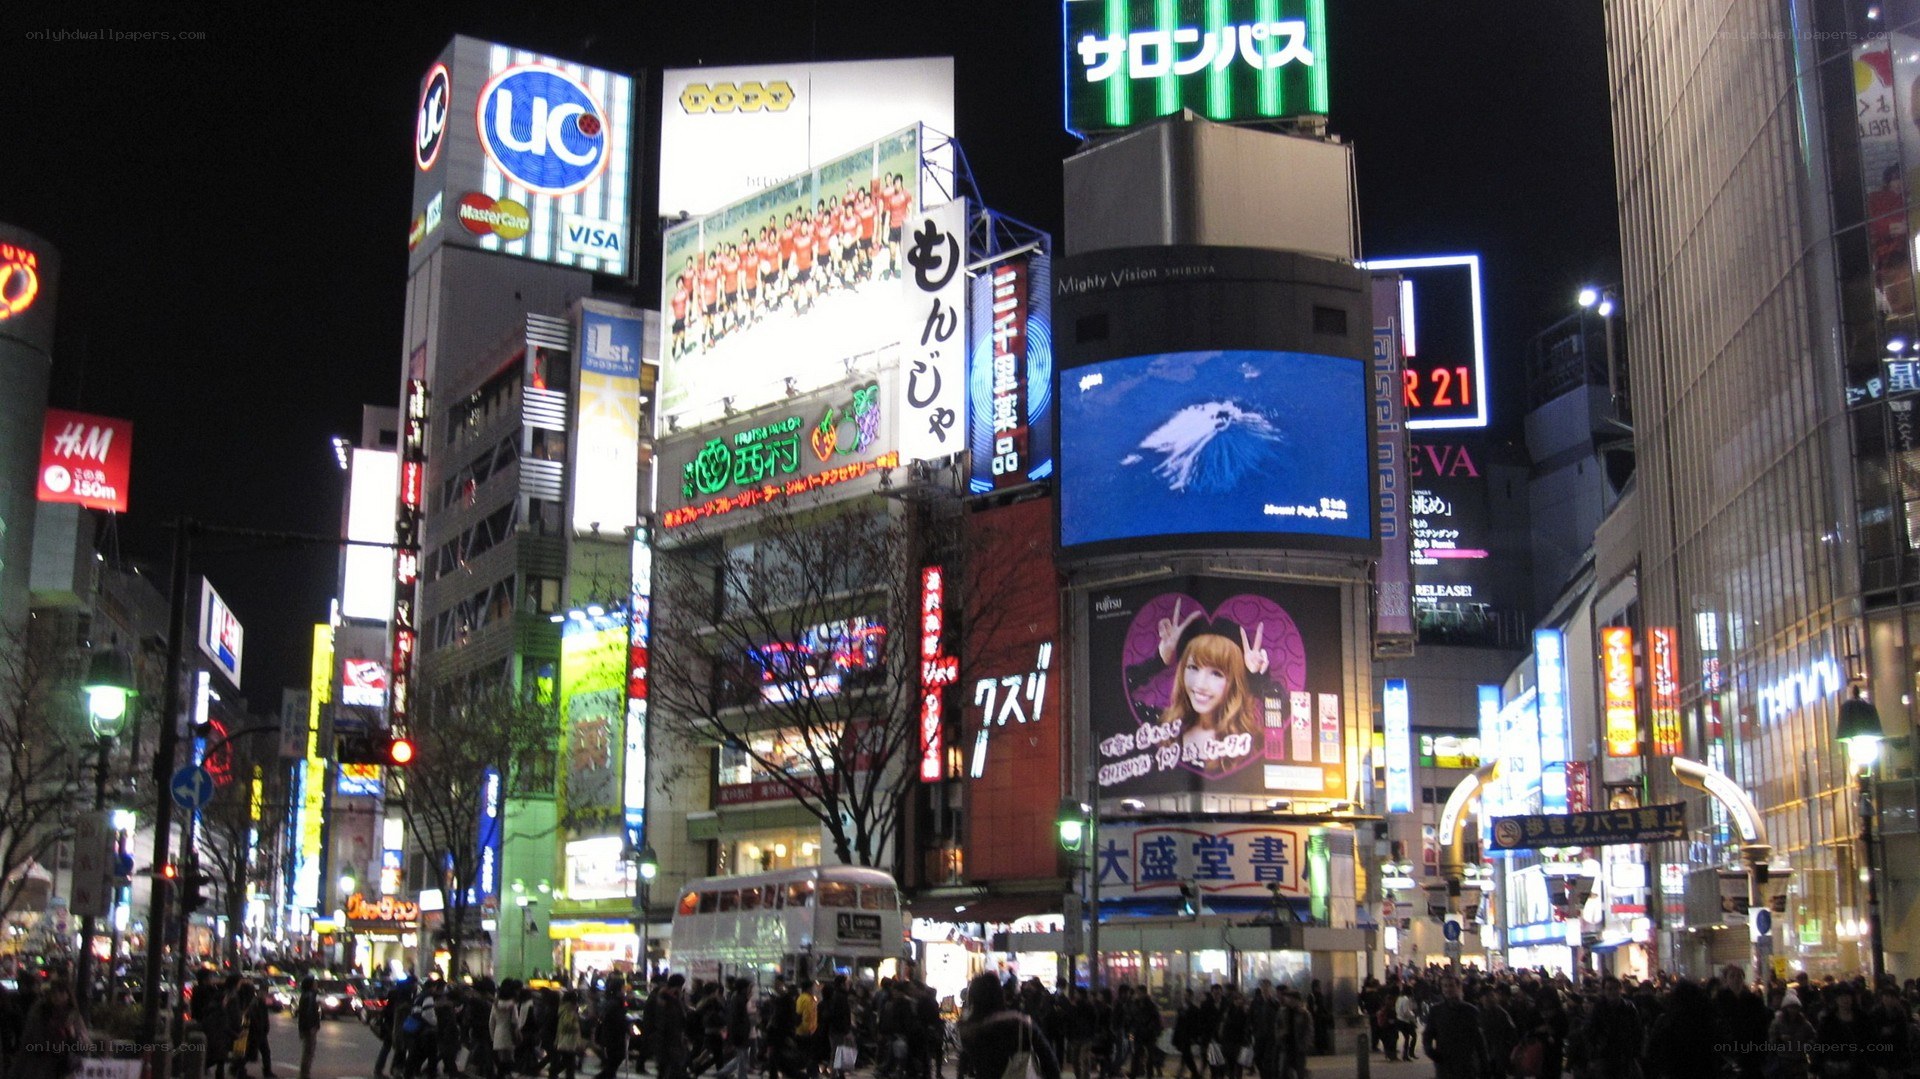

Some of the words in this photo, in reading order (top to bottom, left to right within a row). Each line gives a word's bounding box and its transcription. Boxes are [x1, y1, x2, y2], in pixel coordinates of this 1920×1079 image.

[1077, 20, 1314, 82] サロンパス
[689, 91, 786, 106] TOPY
[460, 204, 529, 230] MasterCard
[568, 223, 620, 250] VISA
[1058, 274, 1108, 295] Mighty
[1111, 266, 1157, 287] Vision
[1165, 265, 1215, 277] SHIBUYA
[907, 218, 960, 443] もんじゃ
[991, 270, 1019, 476] 三千里薬品
[1432, 367, 1469, 406] 21
[54, 421, 114, 465] H&M
[734, 433, 800, 485] 西村
[73, 480, 116, 501] 150m
[1098, 834, 1310, 886] 大盛堂書
